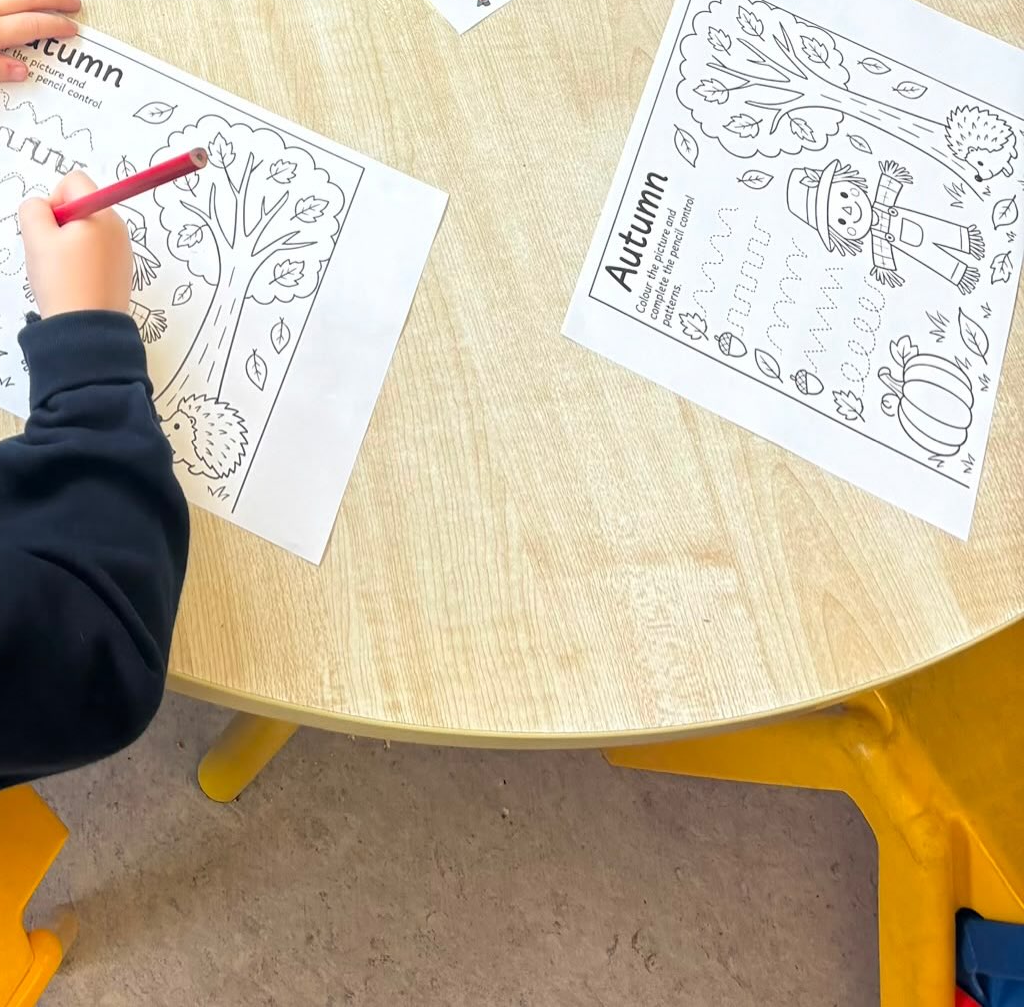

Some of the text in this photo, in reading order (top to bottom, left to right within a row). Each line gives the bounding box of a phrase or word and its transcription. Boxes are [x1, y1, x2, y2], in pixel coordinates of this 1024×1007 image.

[30, 58, 65, 80] picture
[67, 76, 87, 90] and
[34, 74, 103, 110] pencil control
[605, 172, 668, 293] Autumn
[636, 208, 677, 314] Colour the picture and
[650, 194, 695, 320] complete the pencil control
[662, 284, 683, 328] patterns.
